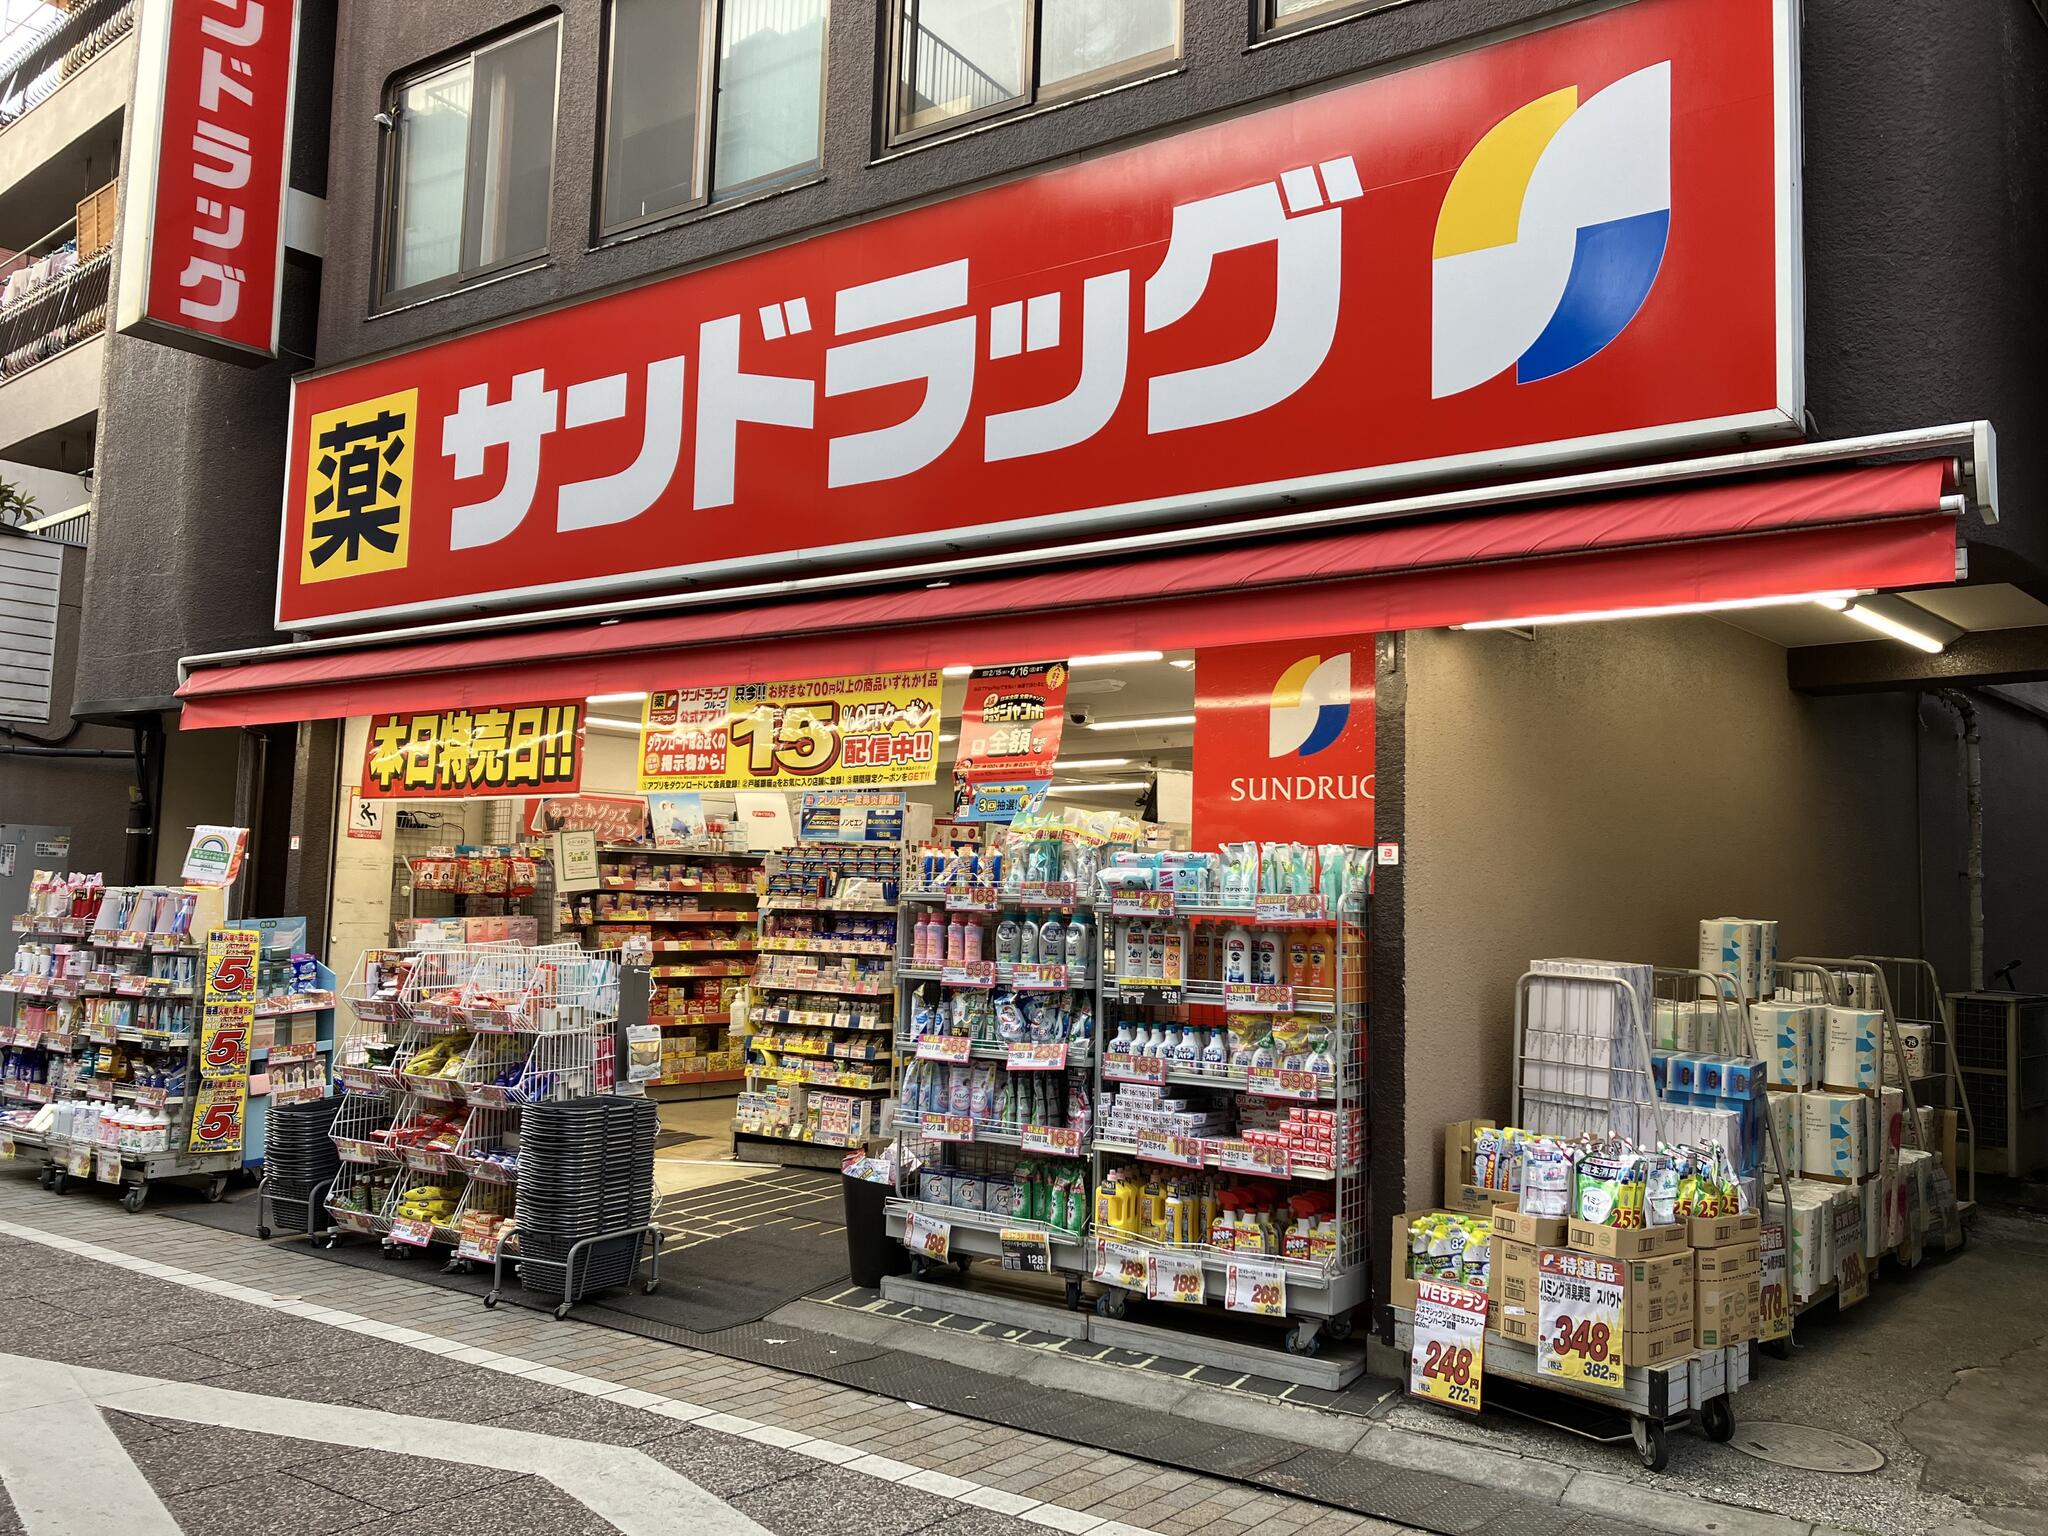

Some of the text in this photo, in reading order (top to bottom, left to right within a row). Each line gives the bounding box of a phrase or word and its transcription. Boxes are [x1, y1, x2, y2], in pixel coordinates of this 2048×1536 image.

[309, 155, 1364, 569] 薬 サンドラッグ
[681, 687, 729, 702] サンドラッグ
[735, 683, 767, 701] 只今!!
[704, 700, 726, 709] グループ
[680, 709, 726, 724] 公式アプリ
[369, 704, 578, 789] 本日特売日!!
[843, 732, 931, 766] 配信中!!
[987, 728, 1032, 755] 全額
[550, 801, 631, 823] あったかグッズ
[924, 1232, 945, 1253] 198
[1027, 1254, 1044, 1264] 128
[1120, 1259, 1144, 1278] 188
[1560, 1256, 1616, 1282] 特選品
[1173, 1274, 1199, 1293] 188
[1251, 1284, 1280, 1305] 268
[1419, 1281, 1487, 1312] WEBチラシ
[1597, 1289, 1622, 1309] スパウト
